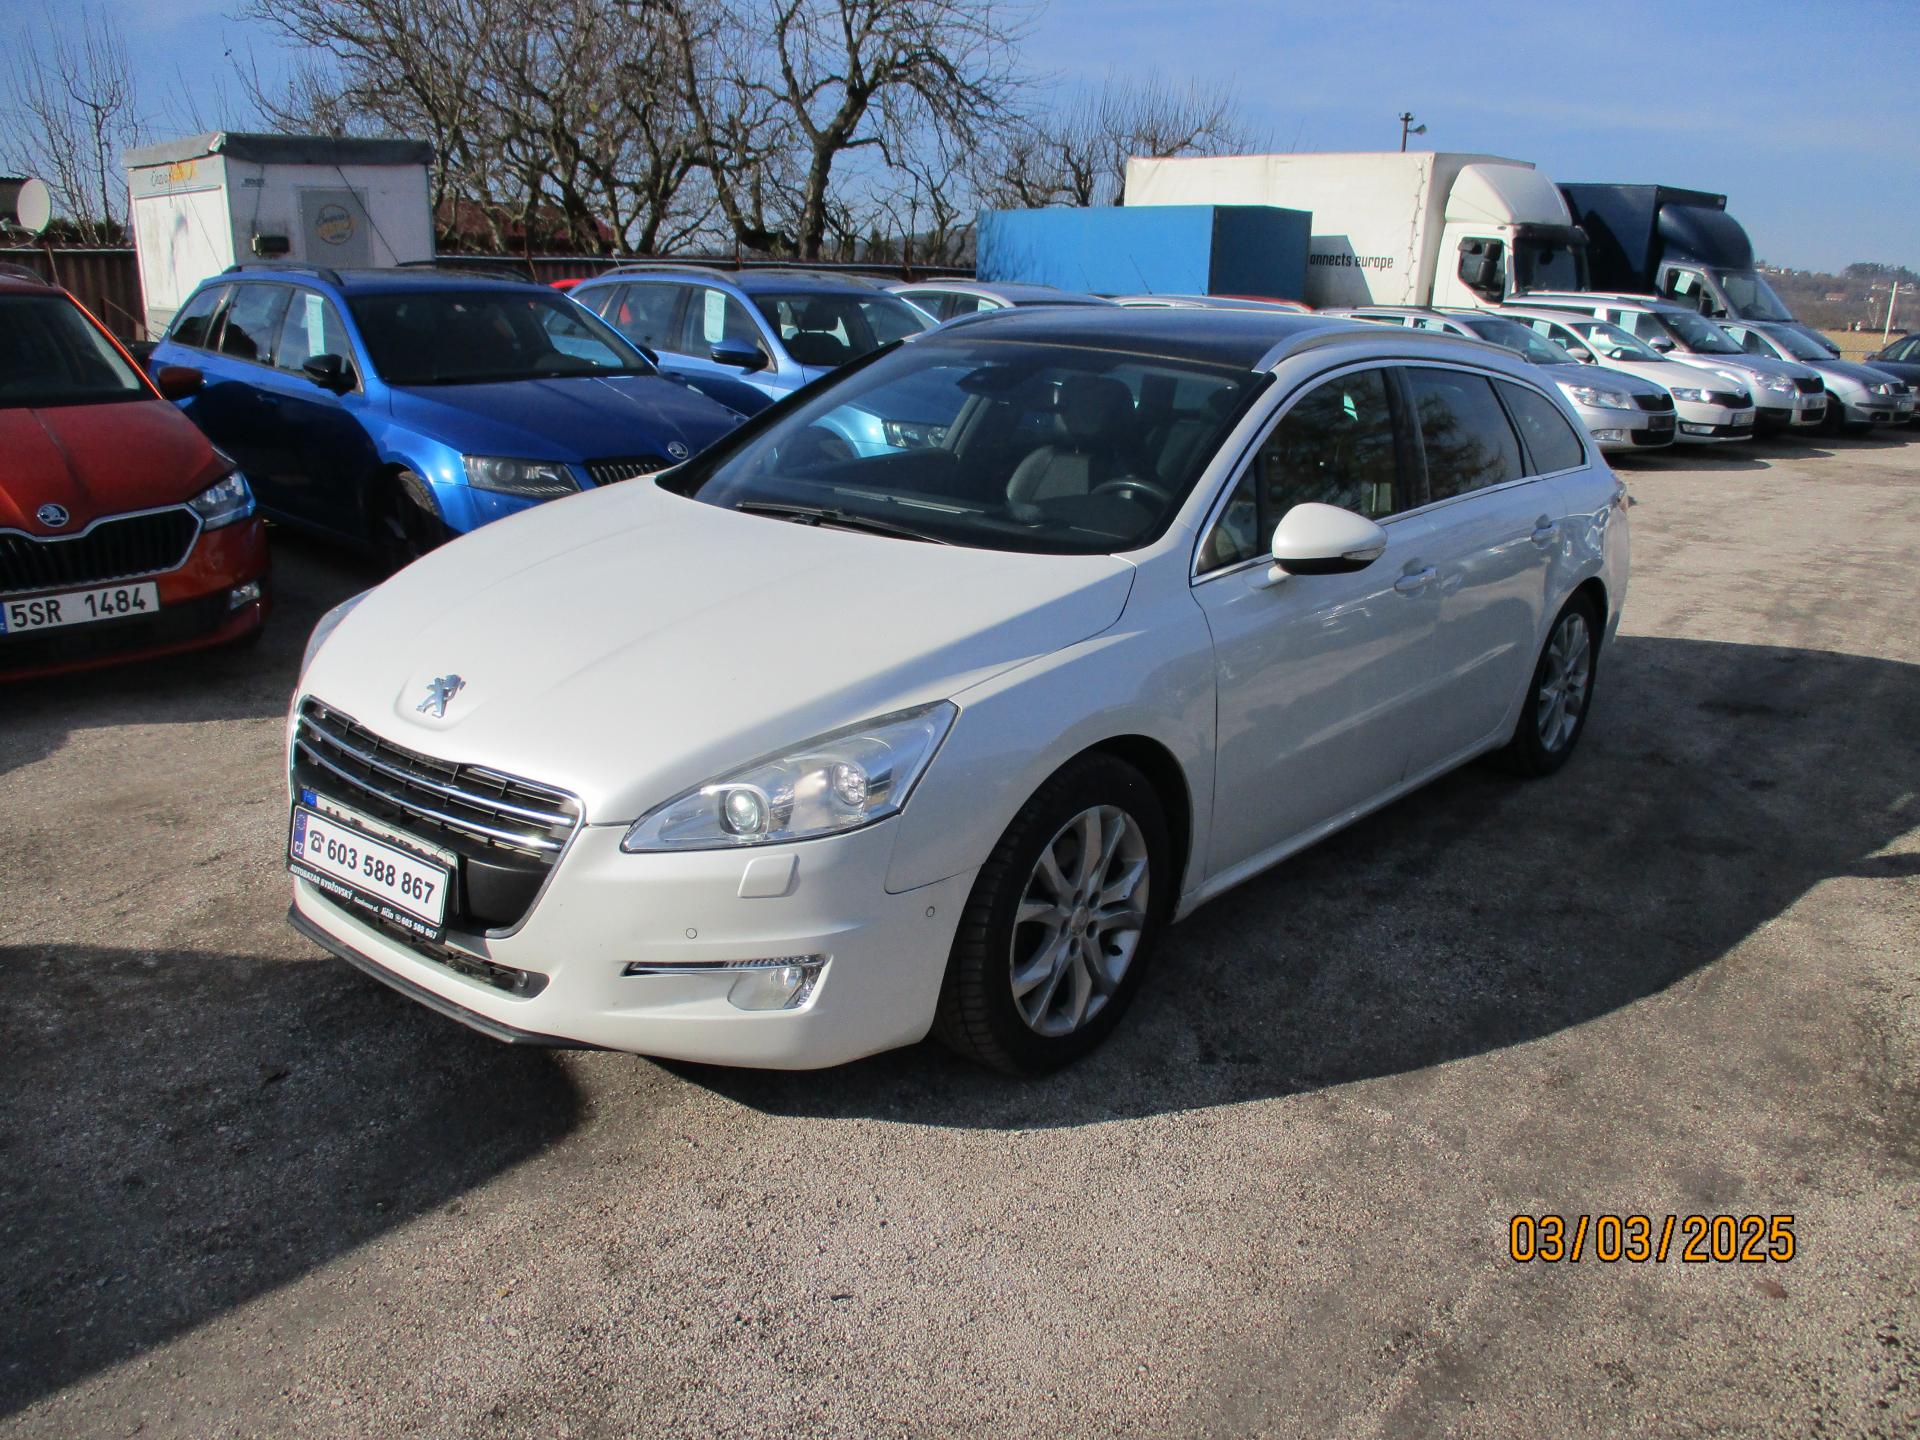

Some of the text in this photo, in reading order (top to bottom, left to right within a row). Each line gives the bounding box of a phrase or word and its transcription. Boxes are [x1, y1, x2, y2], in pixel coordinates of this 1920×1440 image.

[1309, 253, 1394, 272] onnects europe
[10, 587, 146, 627] 5SR 1484
[295, 840, 304, 855] CZ
[327, 839, 435, 904] 603 588 867
